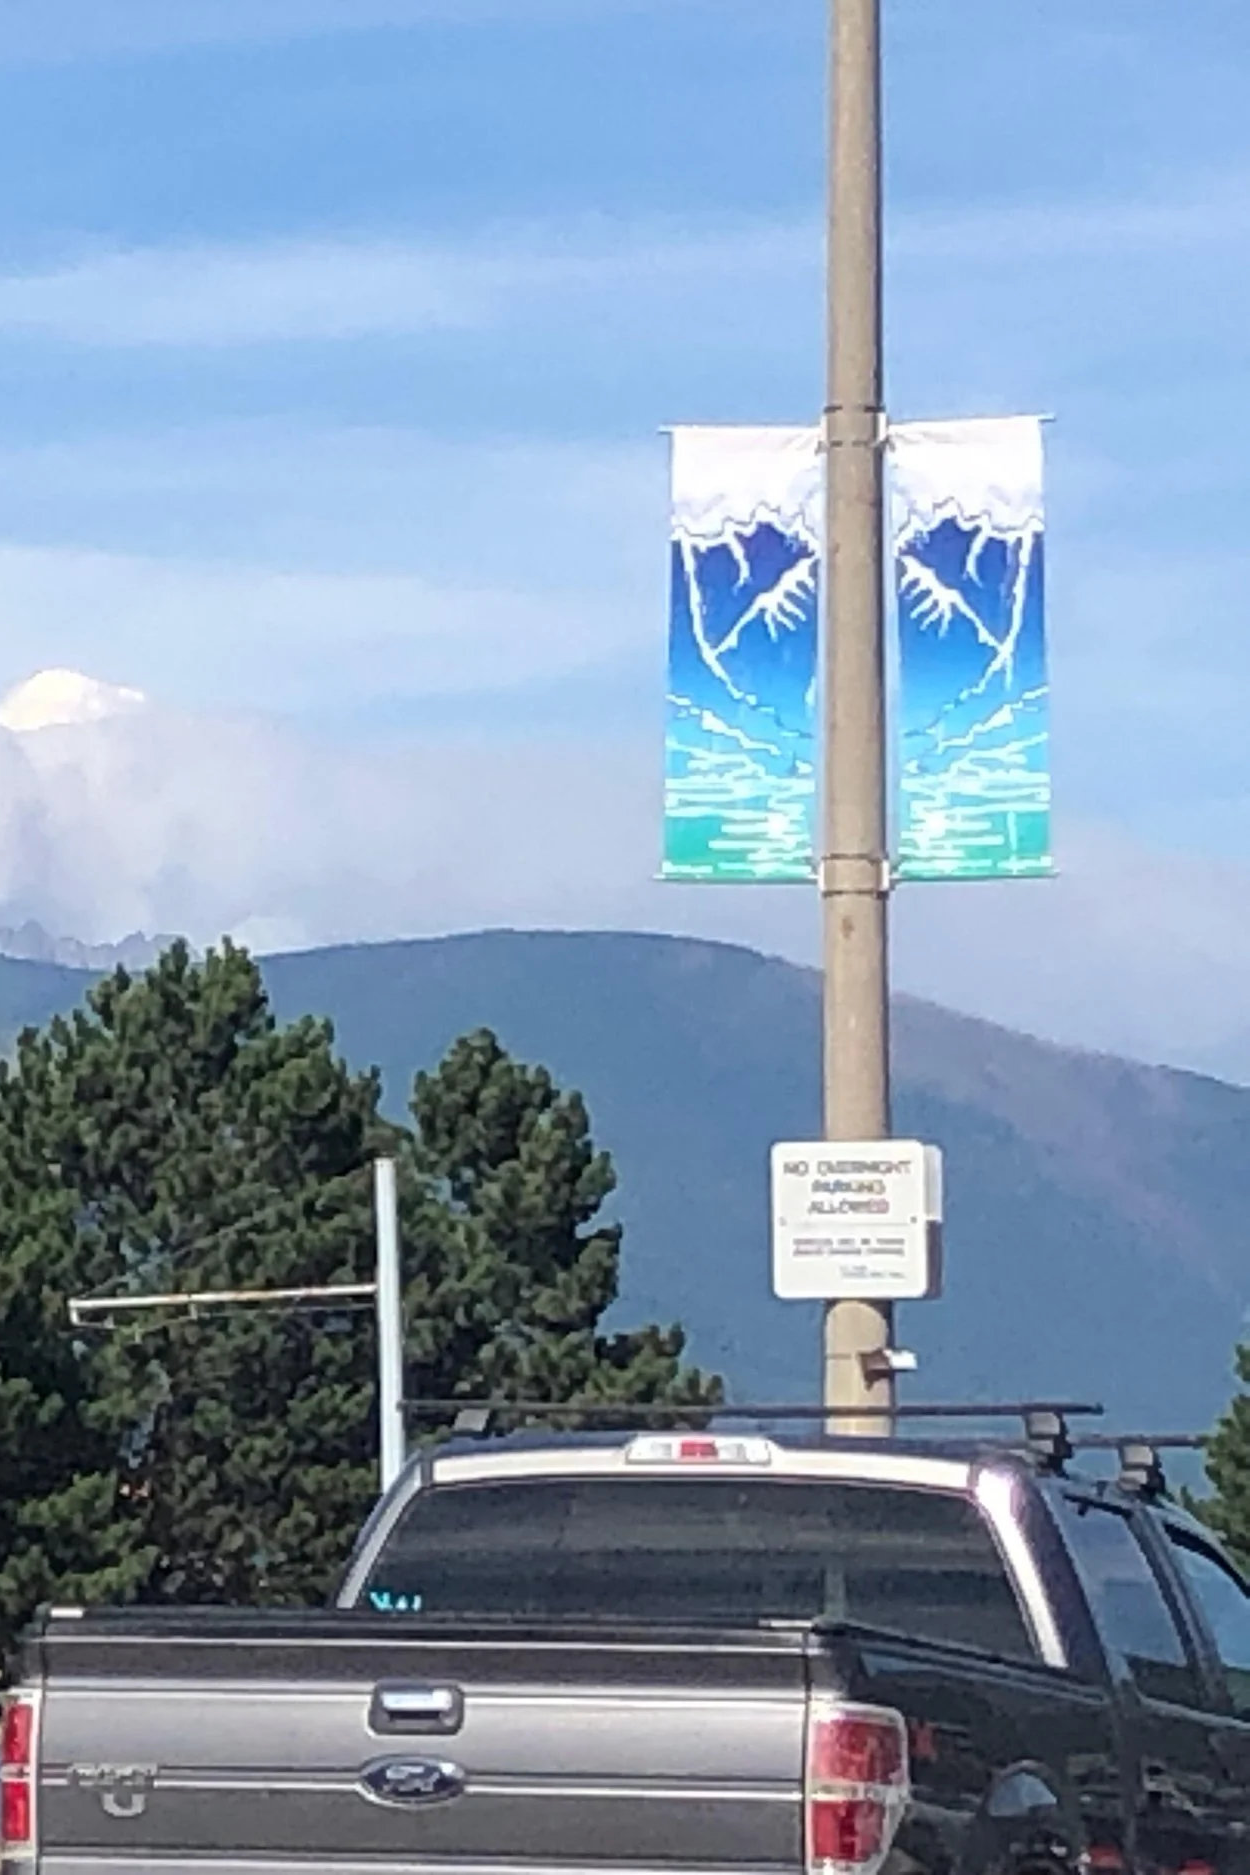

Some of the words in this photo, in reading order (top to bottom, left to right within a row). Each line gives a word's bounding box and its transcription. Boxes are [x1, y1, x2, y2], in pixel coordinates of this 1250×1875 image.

[783, 1160, 809, 1177] NO
[816, 1160, 911, 1177] OVERNIGHT
[811, 1179, 886, 1195] PARKING
[808, 1198, 890, 1214] ALLOWED
